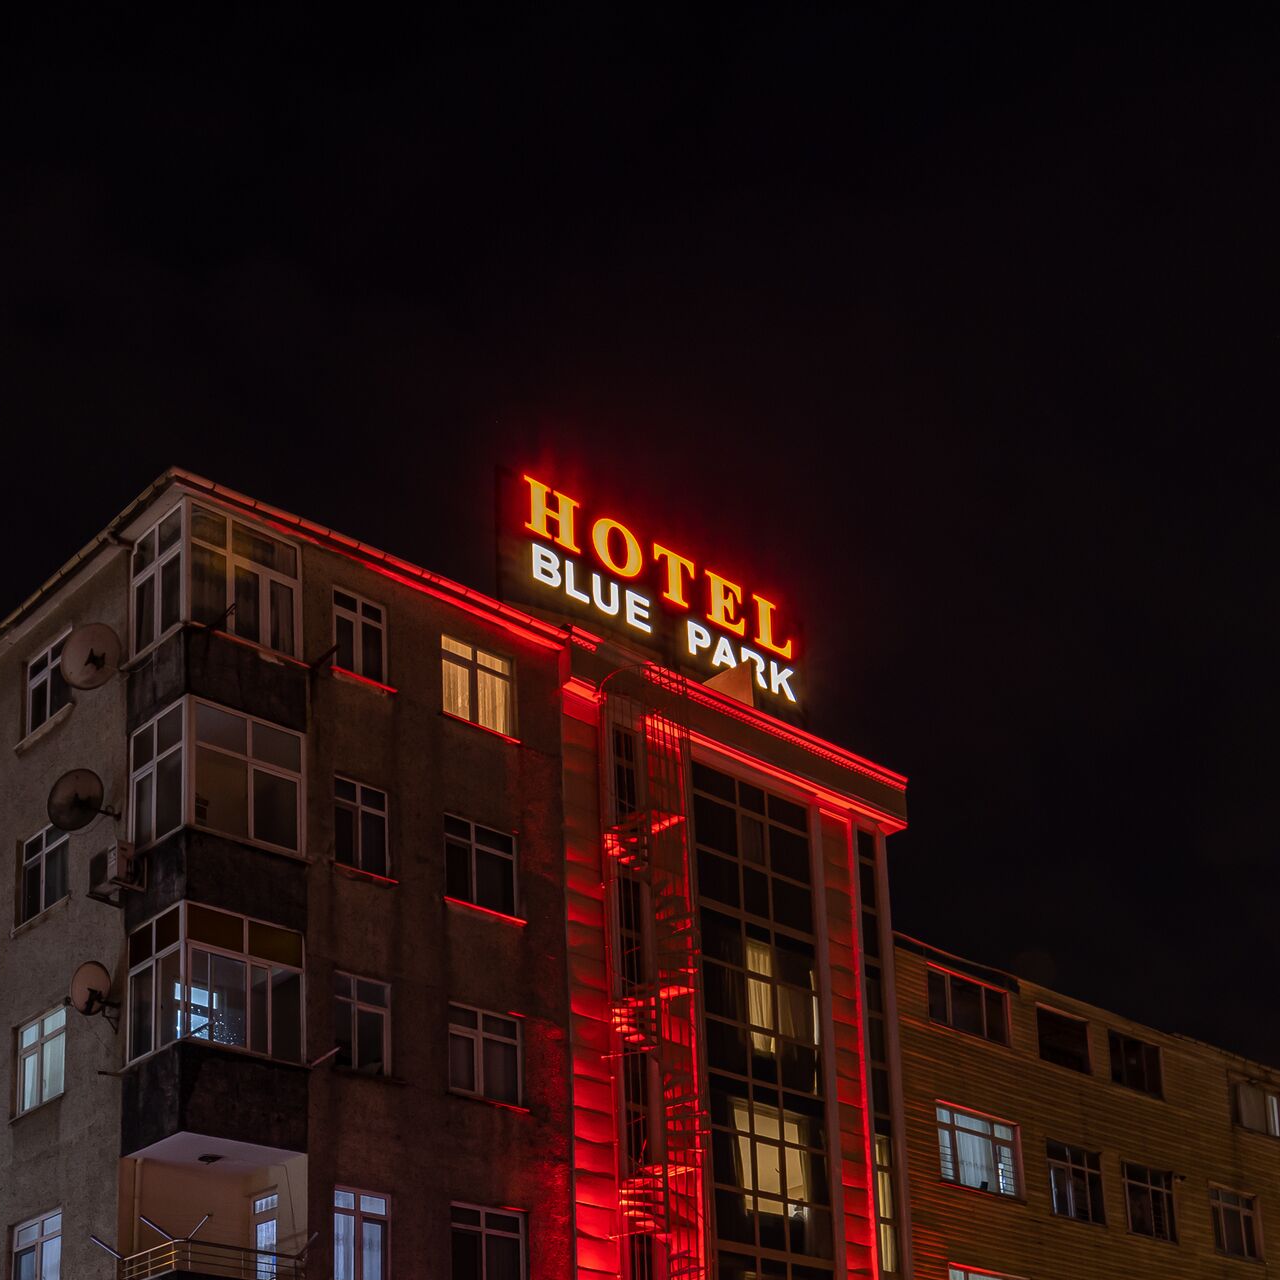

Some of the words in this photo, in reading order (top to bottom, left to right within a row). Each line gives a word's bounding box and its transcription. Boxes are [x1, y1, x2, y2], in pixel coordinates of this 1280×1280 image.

[523, 474, 792, 659] HOTEL
[531, 543, 652, 633] BLUE
[687, 620, 797, 702] PARK
